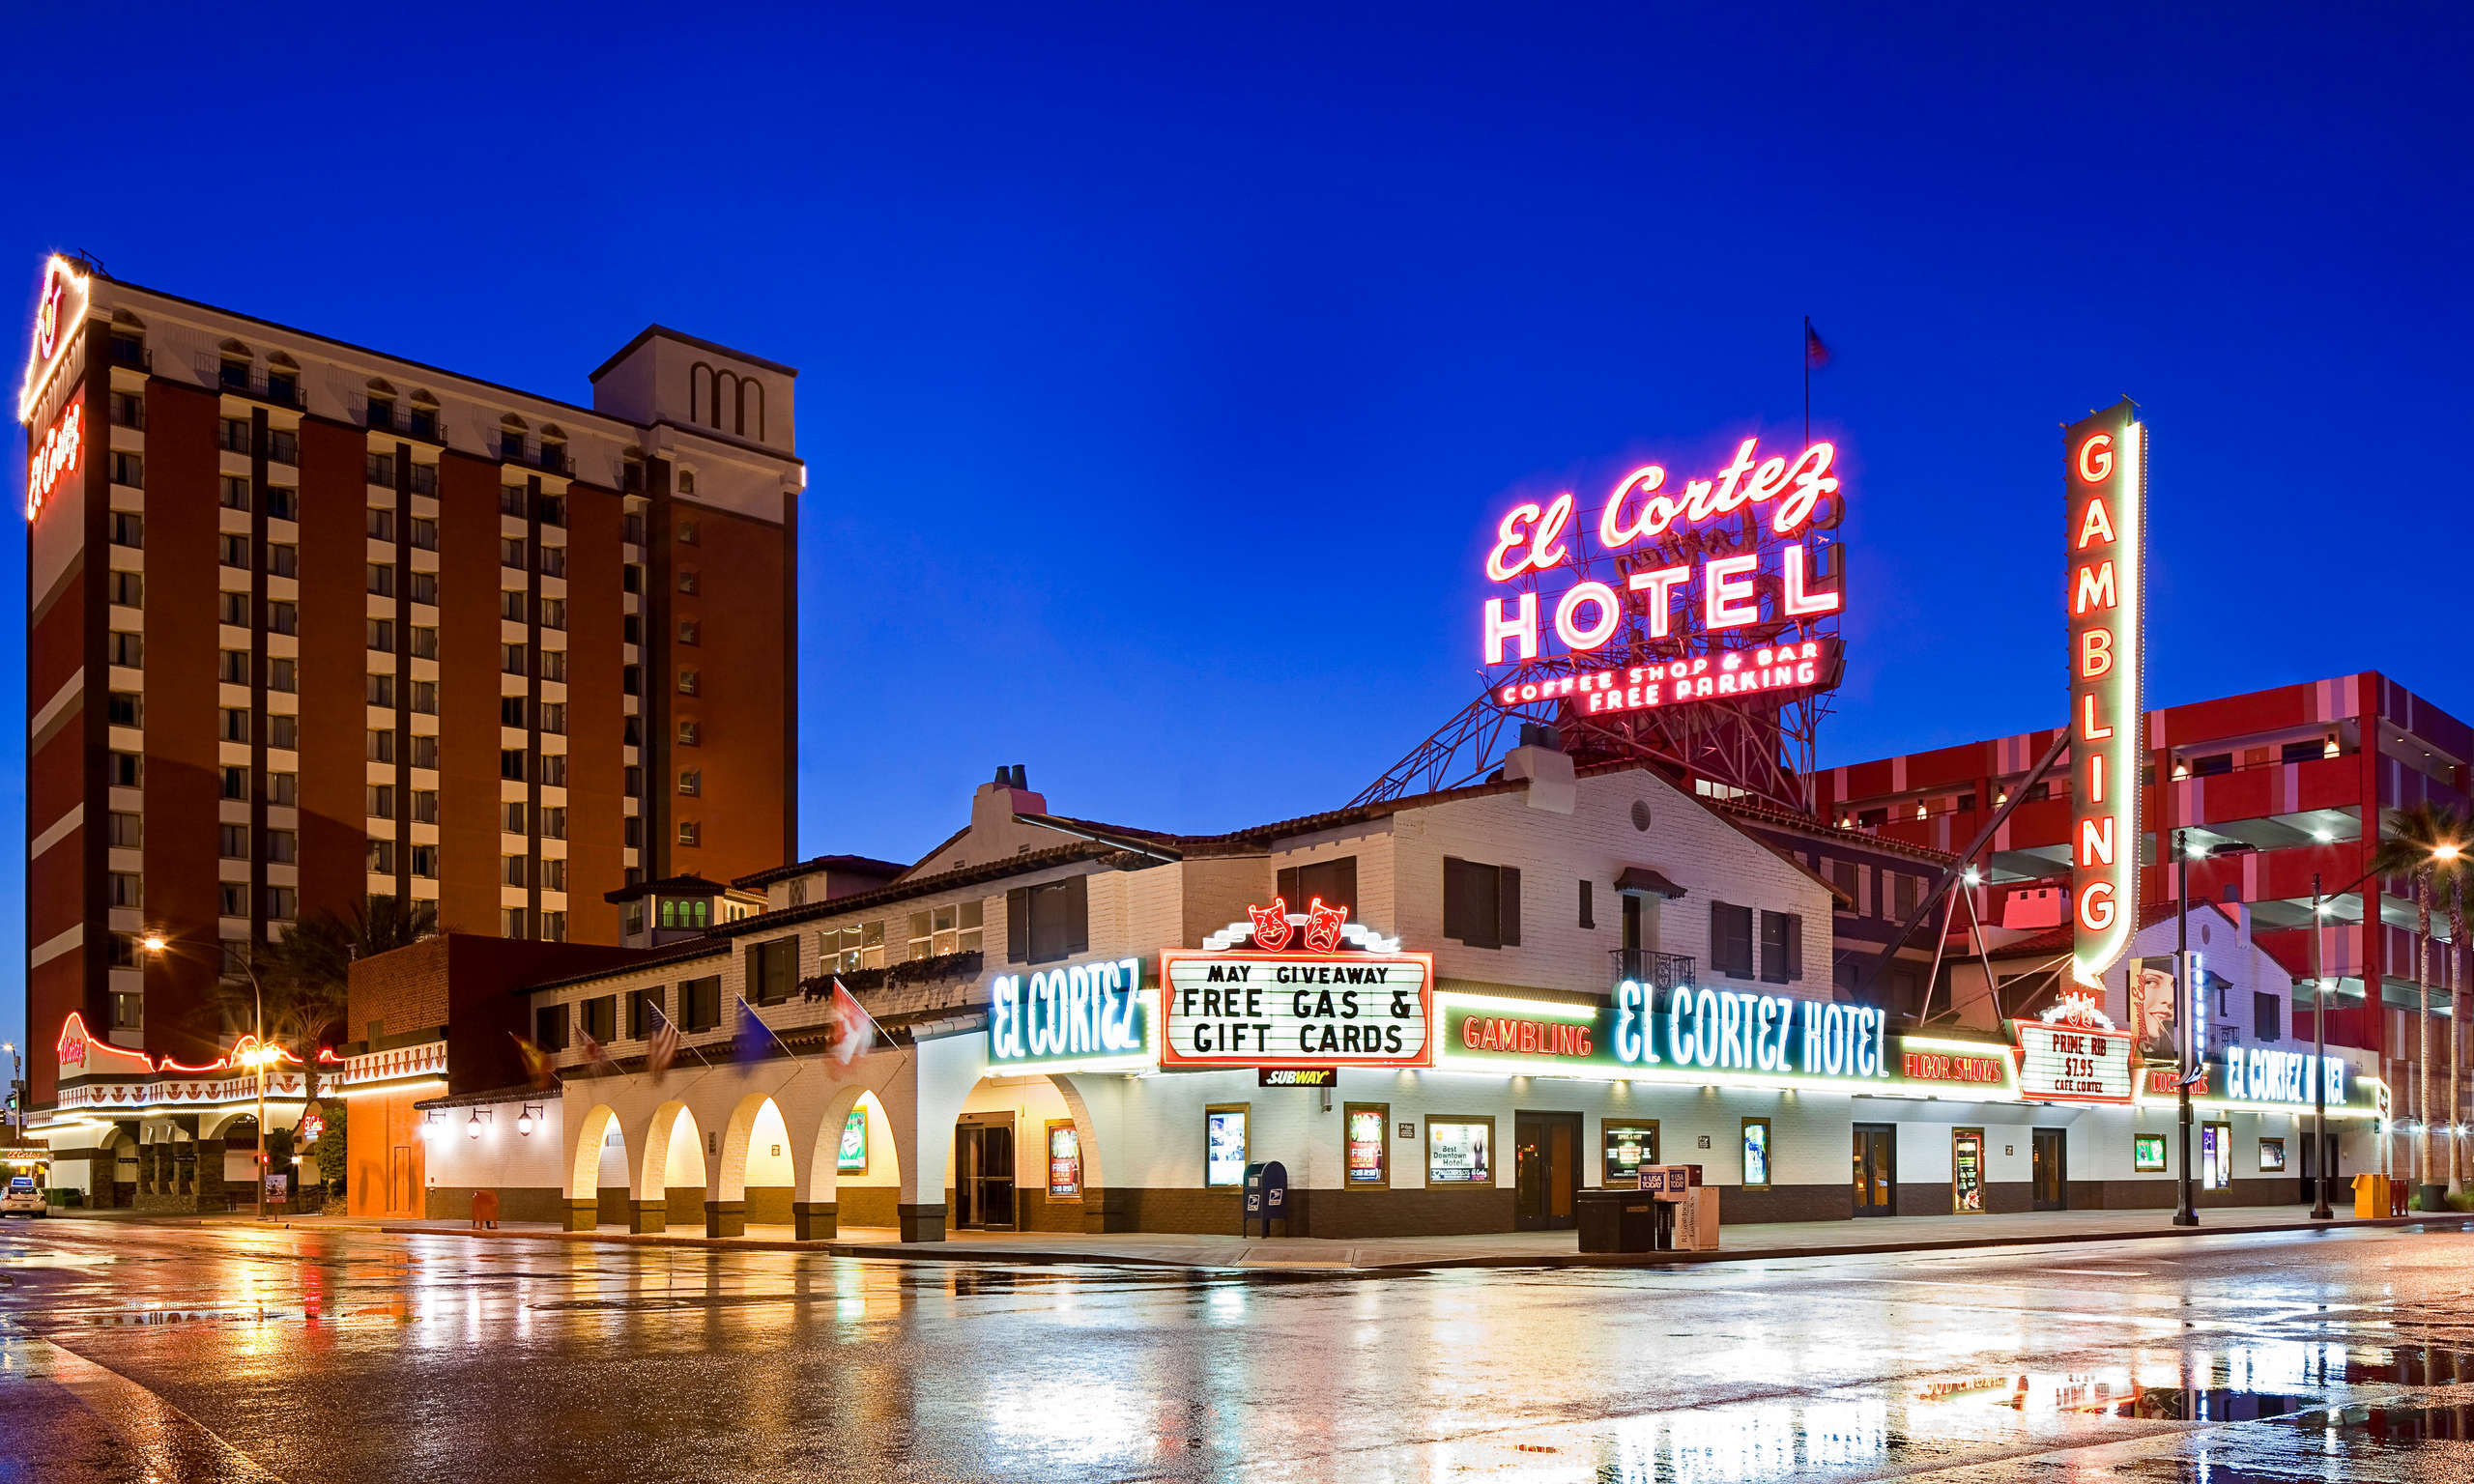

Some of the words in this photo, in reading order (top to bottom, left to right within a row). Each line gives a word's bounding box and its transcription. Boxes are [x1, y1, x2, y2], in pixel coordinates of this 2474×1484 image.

[1485, 494, 1573, 582] El
[1599, 438, 1838, 548] Cortez
[1484, 544, 1838, 665] HOTEL
[1503, 671, 1613, 703] COFFEE
[1629, 658, 1709, 684] SHOP
[1721, 651, 1742, 671] &
[1756, 642, 1819, 668] BAR
[1589, 684, 1660, 713] FREE
[1676, 662, 1815, 701] PARKING
[2075, 433, 2117, 931] GAMBLING
[1207, 965, 1251, 983] MAY
[1277, 966, 1389, 985] GIVEAWAY
[993, 975, 1025, 1059] EL
[1027, 957, 1140, 1056] CORTEZ
[1183, 987, 1263, 1018] FREE
[1293, 989, 1359, 1019] GAS
[1390, 990, 1411, 1019] &
[1194, 1023, 1271, 1053] GIFT
[1299, 1024, 1403, 1053] CARDS
[1463, 1015, 1593, 1057] GAMBLING
[1617, 980, 1660, 1064] EL
[1670, 985, 1793, 1071] CORTEZ
[1803, 1000, 1890, 1078] HOTEL
[2053, 1034, 2085, 1054] PRIME
[2090, 1037, 2107, 1056] RIB
[1265, 1070, 1330, 1085] SUBWAY
[1904, 1052, 1950, 1079] FLOOR
[1952, 1056, 2002, 1083] SHOWS
[2065, 1057, 2094, 1077] $7.95
[2227, 1045, 2248, 1099] EL
[2249, 1047, 2303, 1102] CORTEZ
[2306, 1054, 2346, 1104] HTEL
[2055, 1079, 2074, 1091] CAFE
[2077, 1080, 2103, 1093] CORTEZ
[1052, 1162, 1070, 1173] FREE
[1351, 1148, 1373, 1157] FREE
[1642, 1181, 1663, 1189] TODAY
